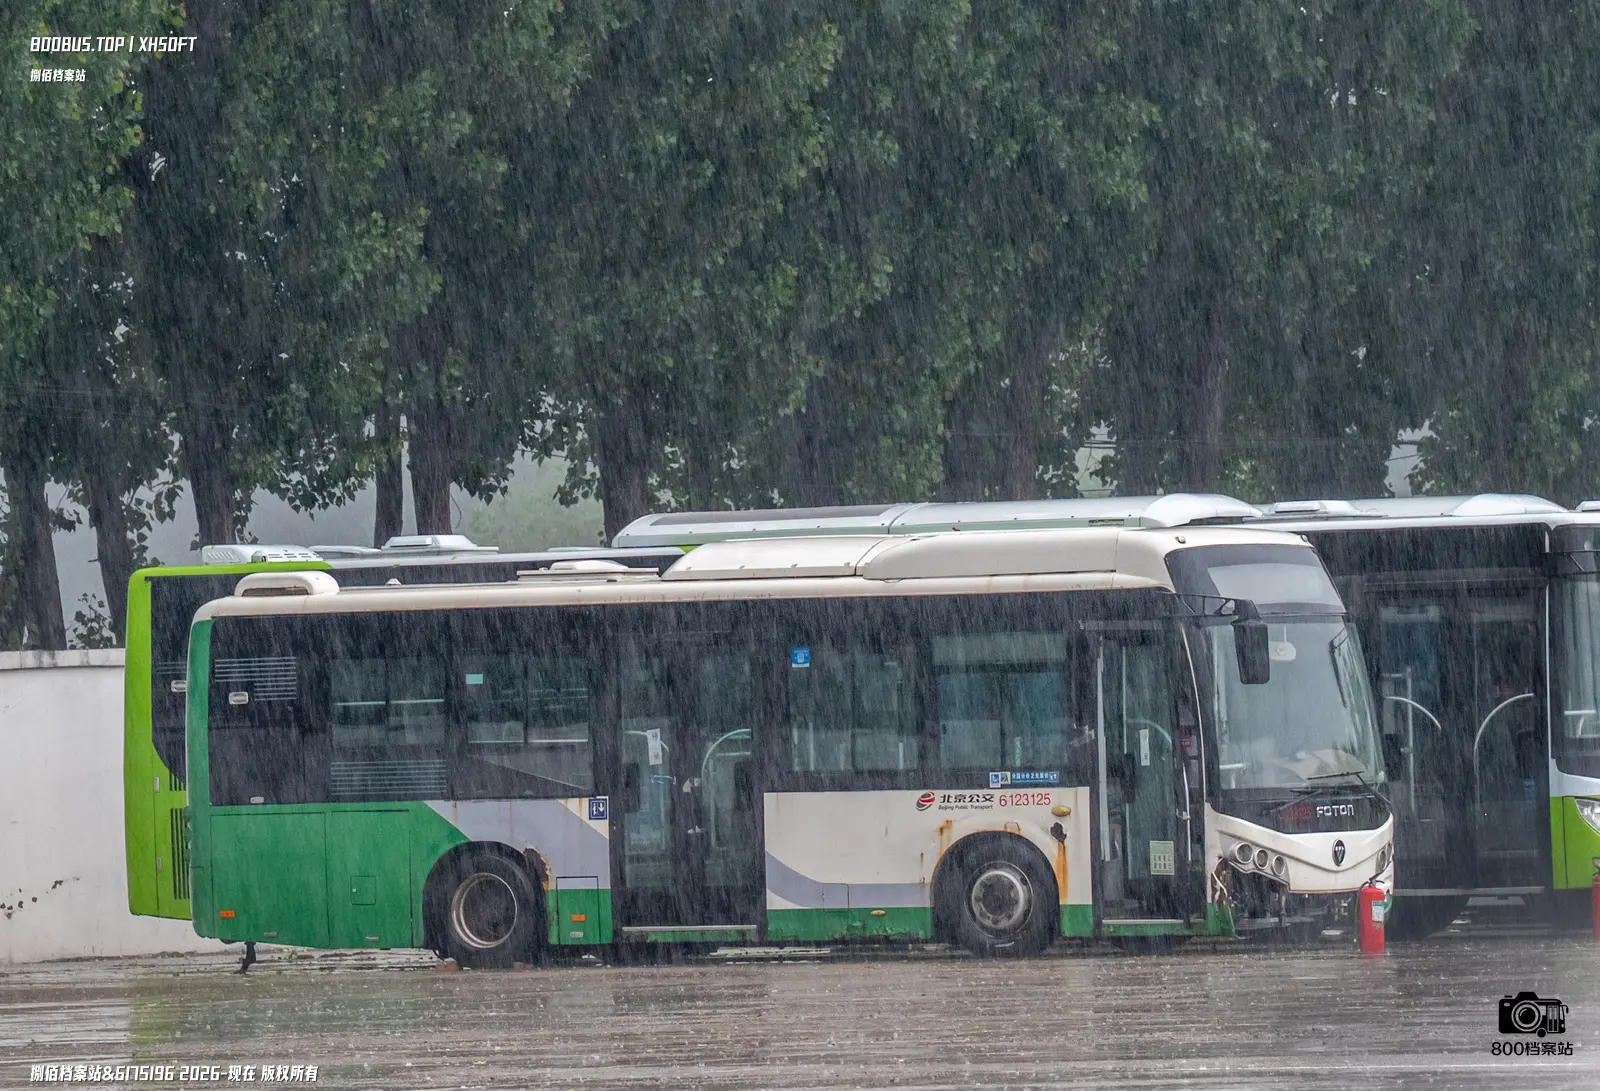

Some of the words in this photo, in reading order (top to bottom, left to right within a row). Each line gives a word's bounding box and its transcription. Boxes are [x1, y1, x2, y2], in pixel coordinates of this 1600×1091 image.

[940, 793, 995, 803] 北京公交
[999, 793, 1051, 807] 6123125
